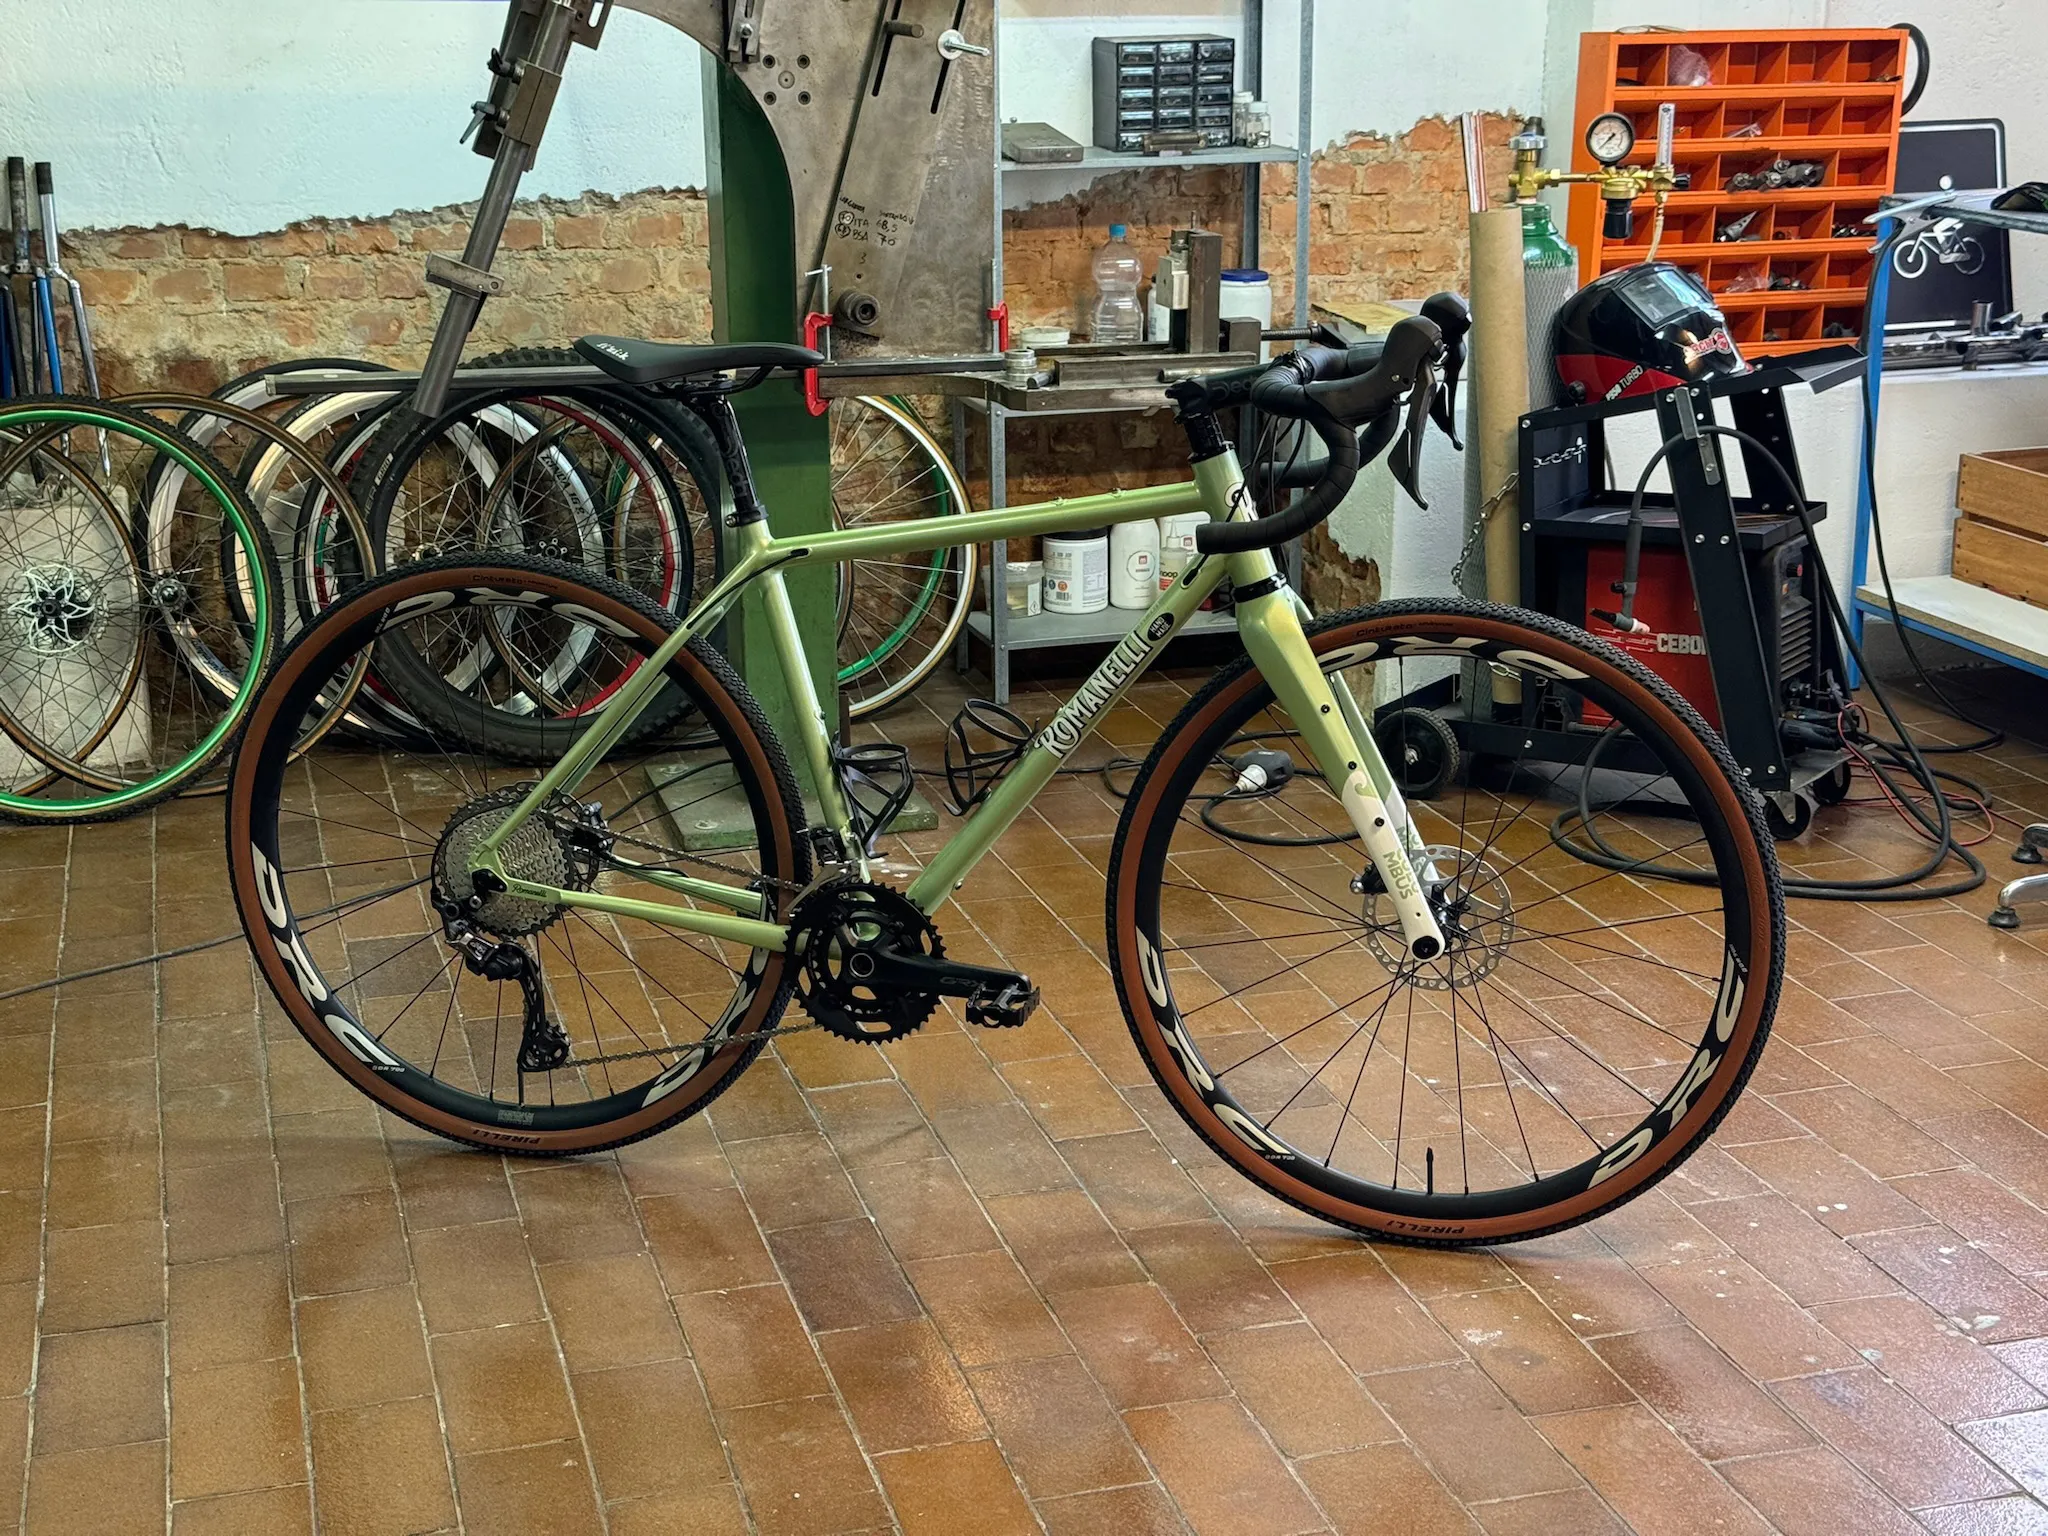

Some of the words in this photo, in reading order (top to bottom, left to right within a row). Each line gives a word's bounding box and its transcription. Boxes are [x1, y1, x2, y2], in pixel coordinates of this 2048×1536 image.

[1620, 364, 1644, 388] TURBO
[1149, 616, 1165, 634] HAND
[1155, 621, 1171, 638] MADE
[1033, 630, 1154, 759] ROMANELLI
[1383, 851, 1413, 899] MBUS
[511, 883, 548, 898] Romanelli
[472, 1129, 541, 1144] PIRELLI
[1386, 1220, 1465, 1234] PIRELLI
